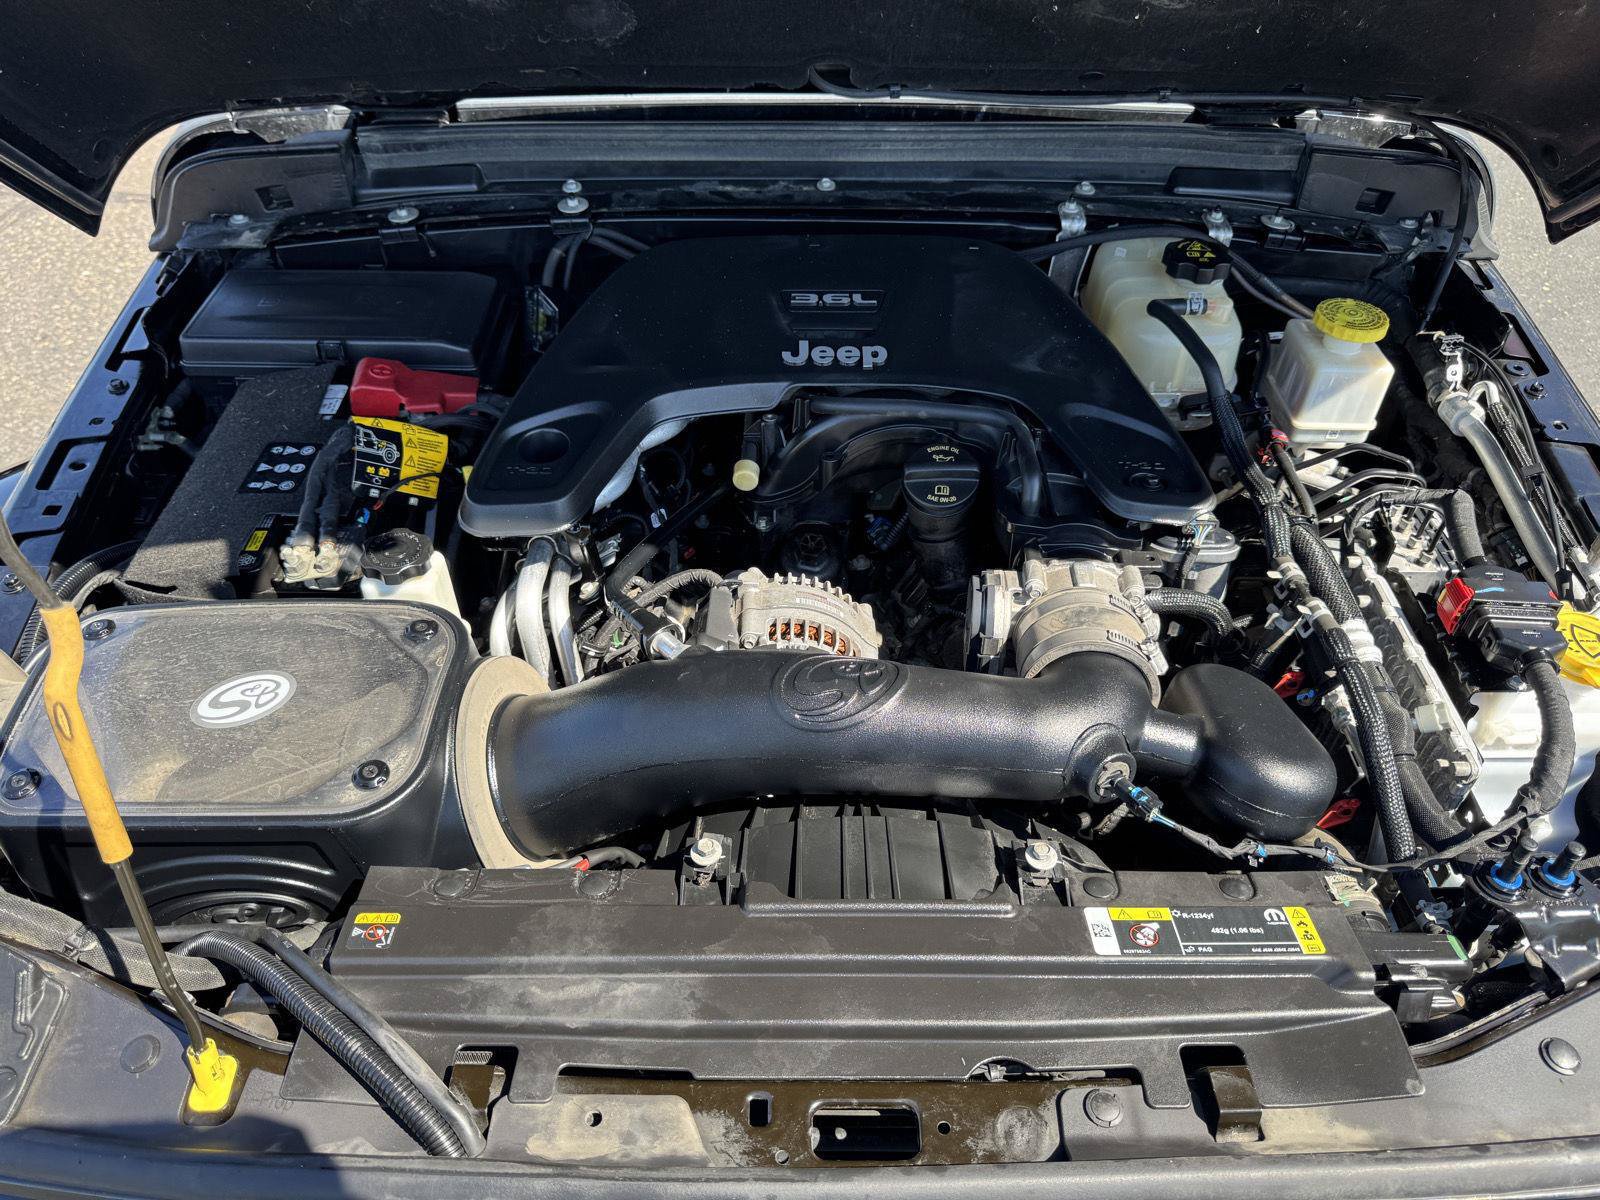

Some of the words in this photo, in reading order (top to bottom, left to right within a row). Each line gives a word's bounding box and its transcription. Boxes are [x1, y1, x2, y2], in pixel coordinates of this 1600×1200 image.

[790, 293, 877, 307] 3.6L
[781, 340, 888, 370] Jeep
[926, 445, 950, 453] ENGINE
[926, 494, 939, 502] SAE
